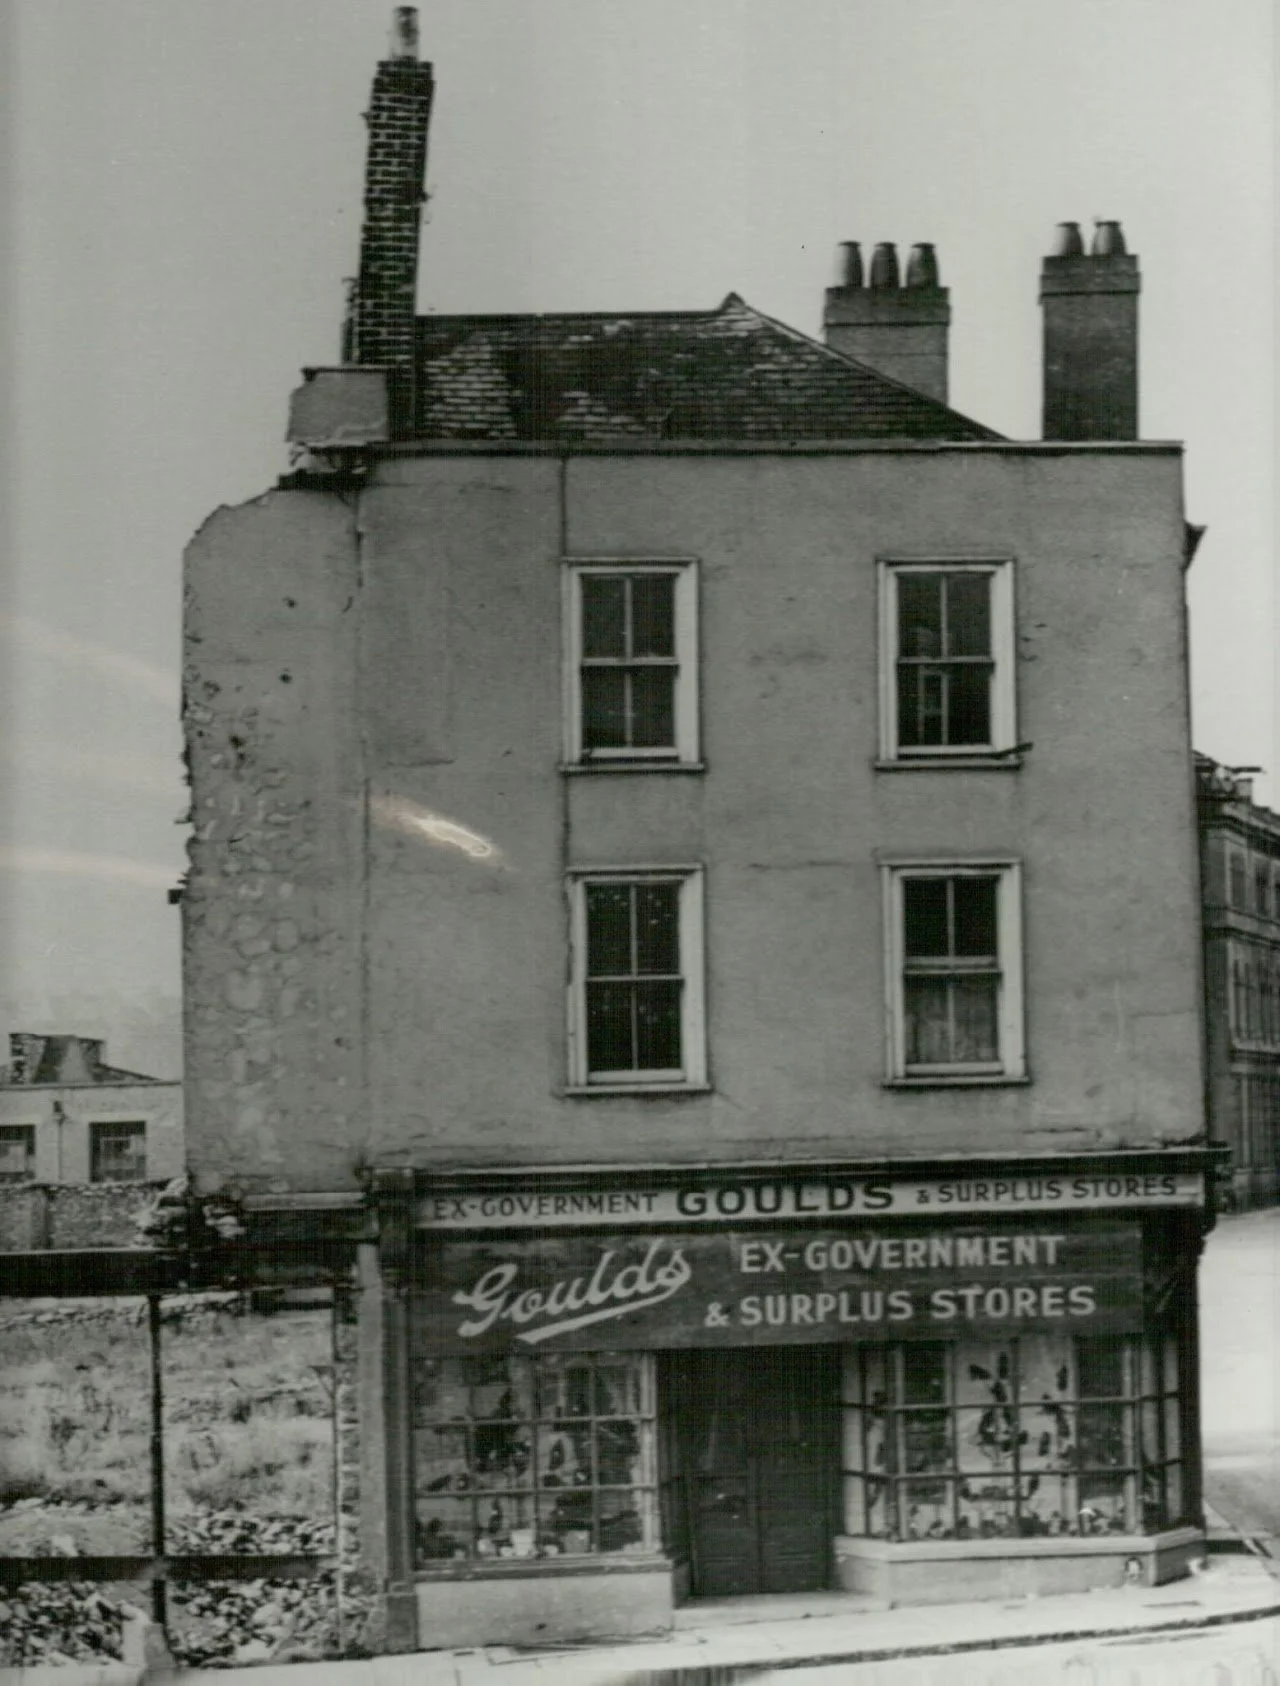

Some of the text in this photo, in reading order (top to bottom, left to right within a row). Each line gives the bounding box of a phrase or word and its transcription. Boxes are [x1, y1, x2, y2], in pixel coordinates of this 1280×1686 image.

[433, 1175, 1177, 1221] EX-GOVERNMENT GOULDS & SURPLUS STORES
[739, 1234, 1066, 1274] EX-GOVERNMENT
[451, 1237, 692, 1345] Goulds
[703, 1285, 1097, 1329] & SURPLUS STORES
